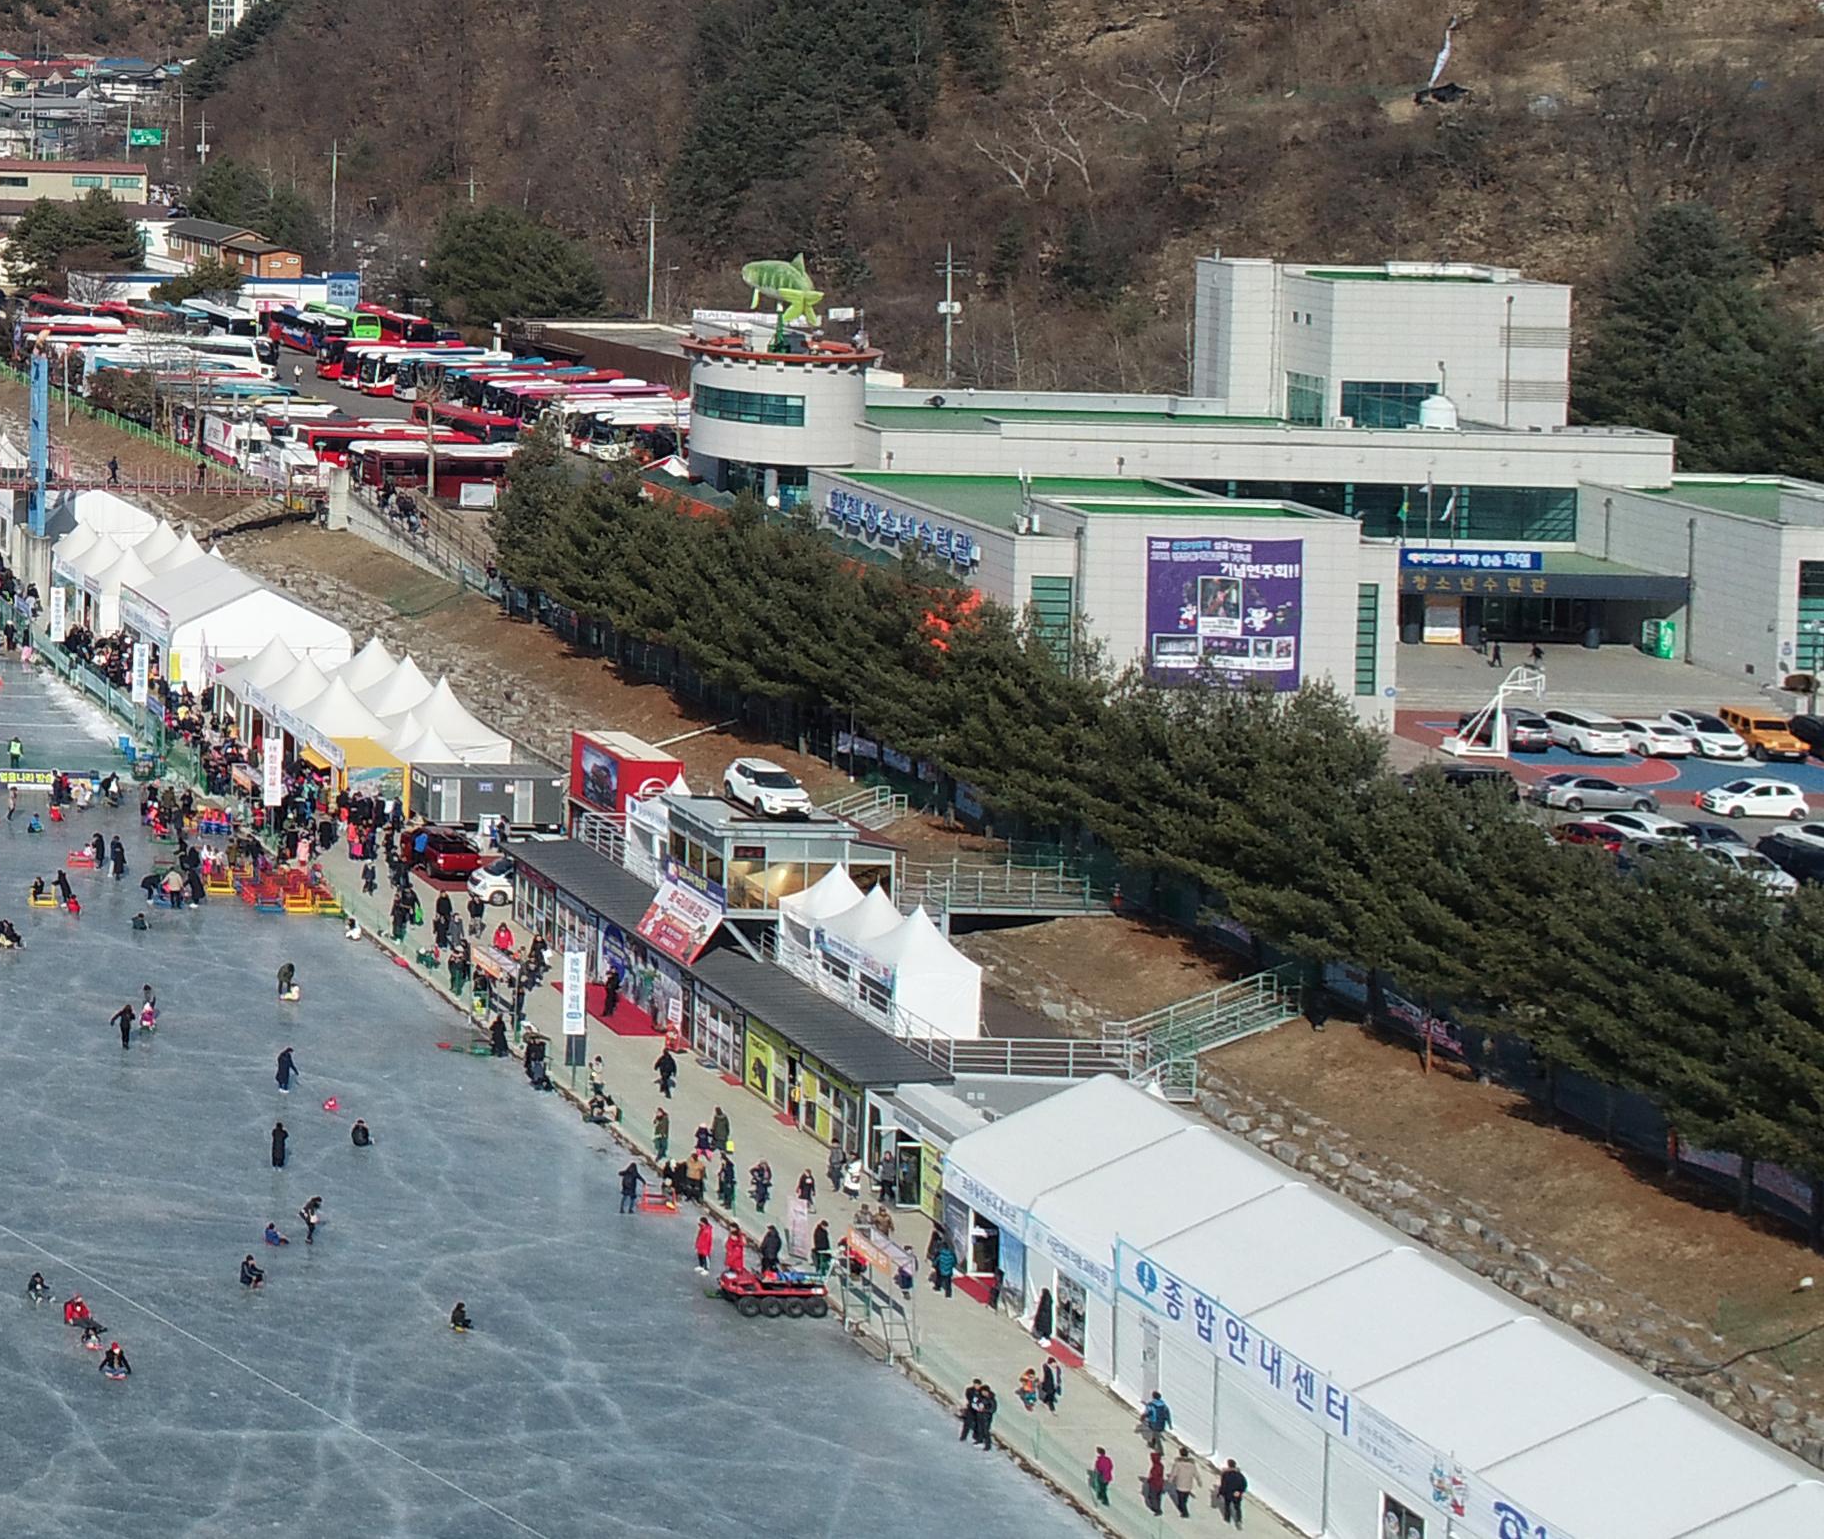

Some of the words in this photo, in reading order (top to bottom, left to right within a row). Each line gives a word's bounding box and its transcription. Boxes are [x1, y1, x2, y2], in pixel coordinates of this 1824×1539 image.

[827, 488, 973, 567] 화천청소년수련관
[1220, 563, 1300, 579] 기념연주회!!
[1504, 552, 1531, 568] 화천
[1162, 1276, 1349, 1436] 종합안내센터
